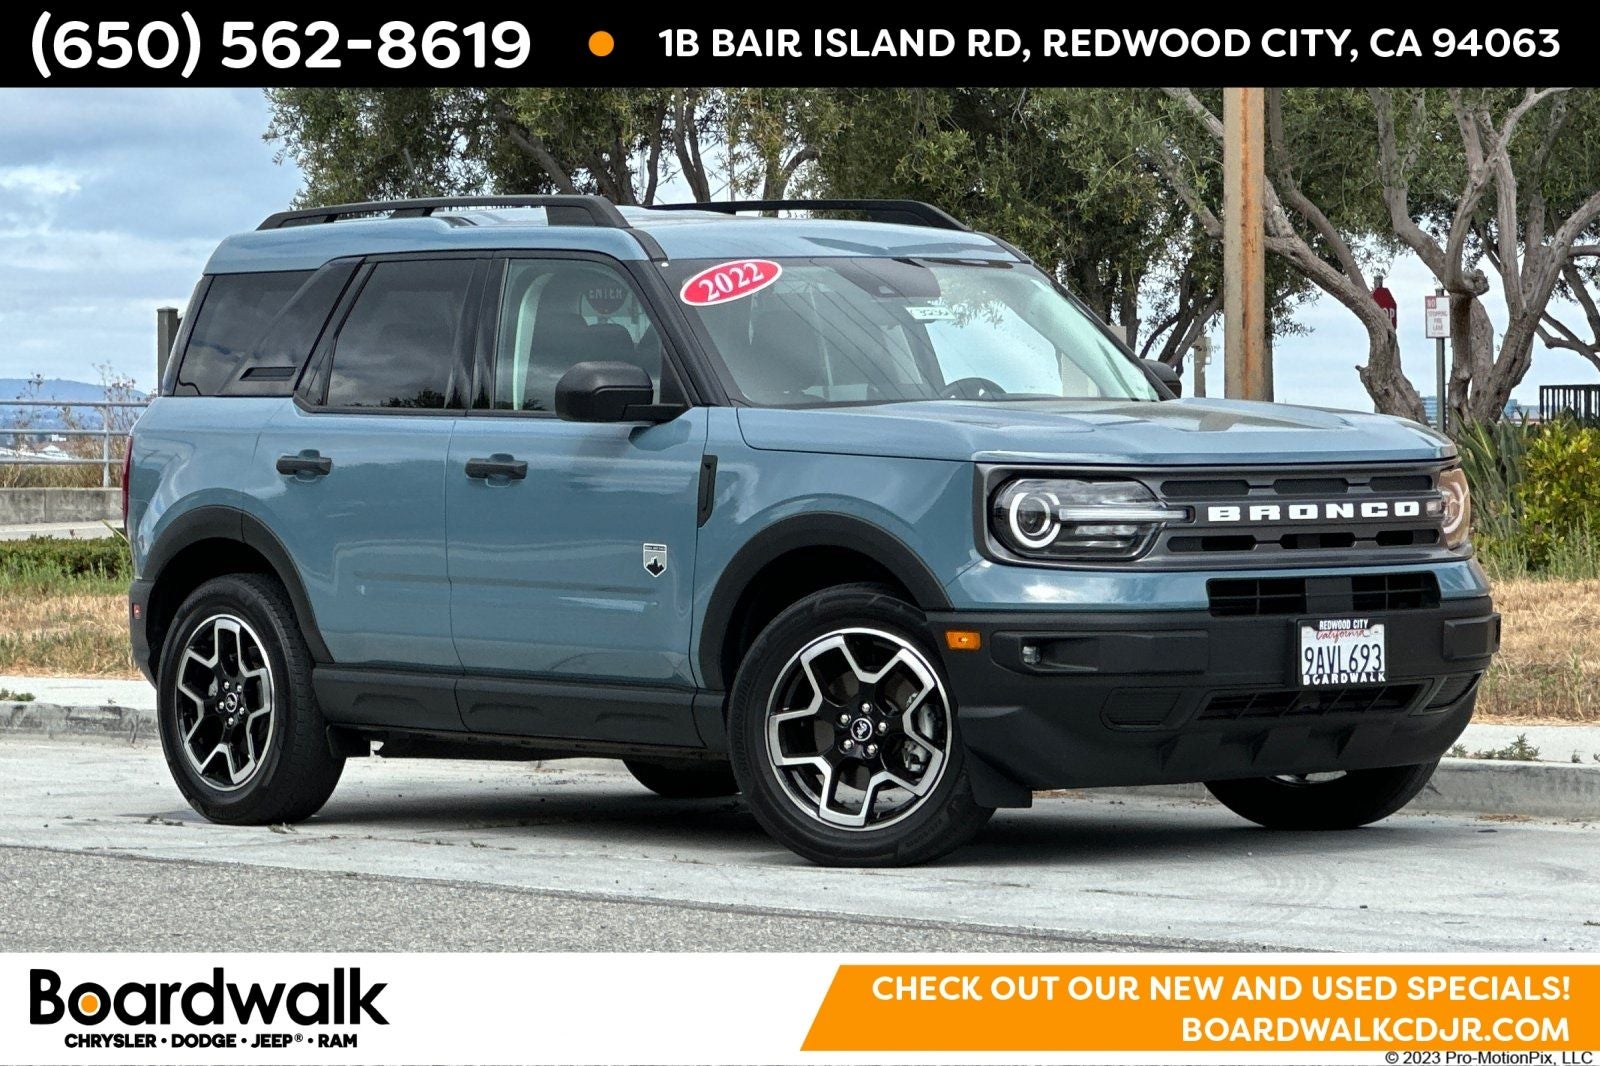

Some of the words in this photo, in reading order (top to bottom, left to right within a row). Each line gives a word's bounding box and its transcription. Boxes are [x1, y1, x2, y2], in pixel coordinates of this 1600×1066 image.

[699, 263, 764, 301] 2022
[1207, 501, 1420, 522] BRONCO
[1319, 619, 1351, 630] REDWOOD
[1353, 618, 1369, 629] CITY
[1304, 644, 1382, 675] 9AVL693
[1303, 672, 1386, 686] BOARDWALK
